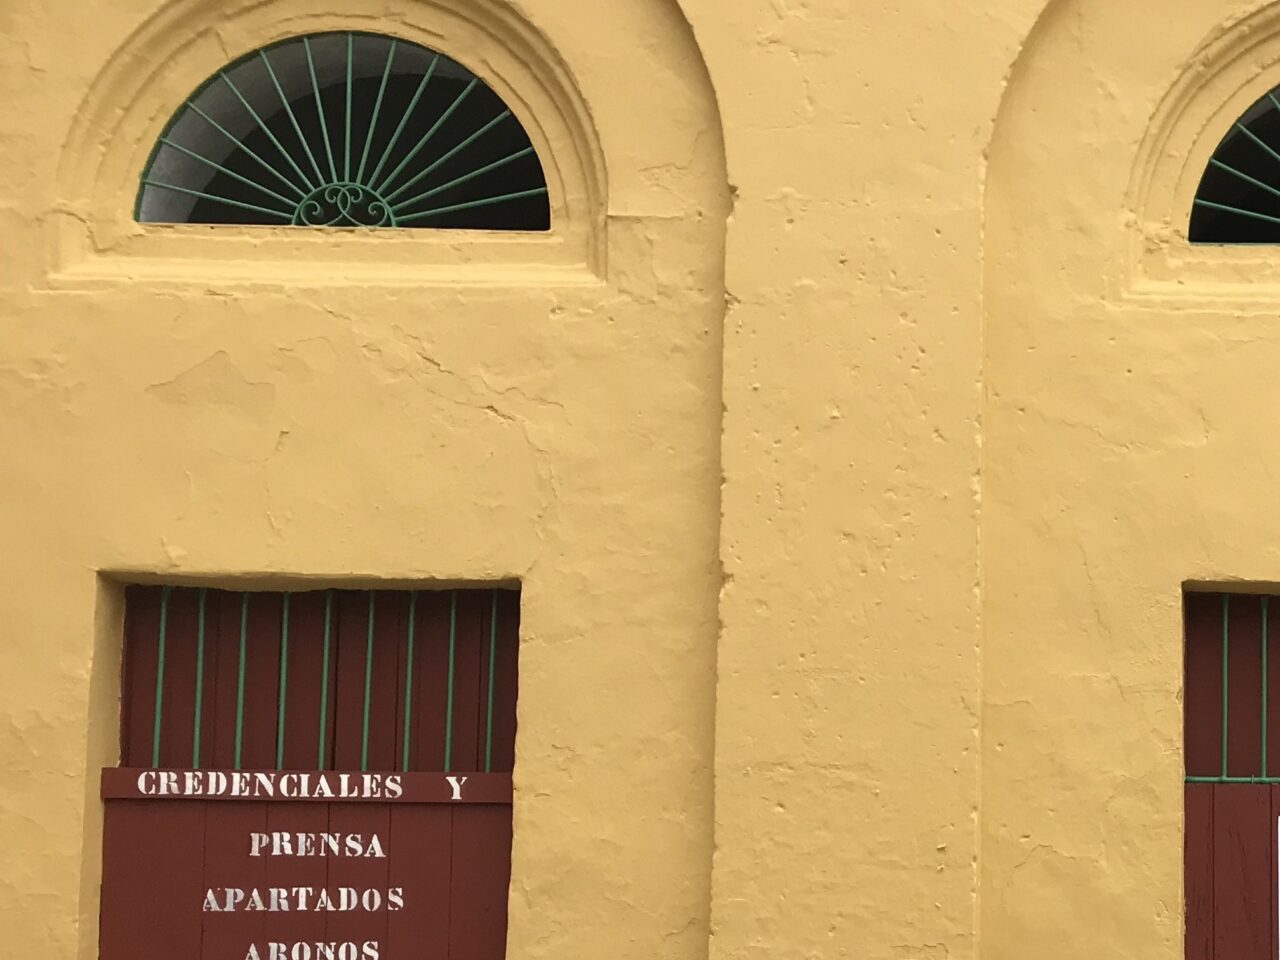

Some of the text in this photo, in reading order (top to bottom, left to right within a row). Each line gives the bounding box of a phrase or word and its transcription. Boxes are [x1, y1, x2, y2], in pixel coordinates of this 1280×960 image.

[137, 771, 468, 800] CREDENCIALES Y
[249, 831, 386, 858] PRENSA
[202, 887, 404, 912] APARTADOS
